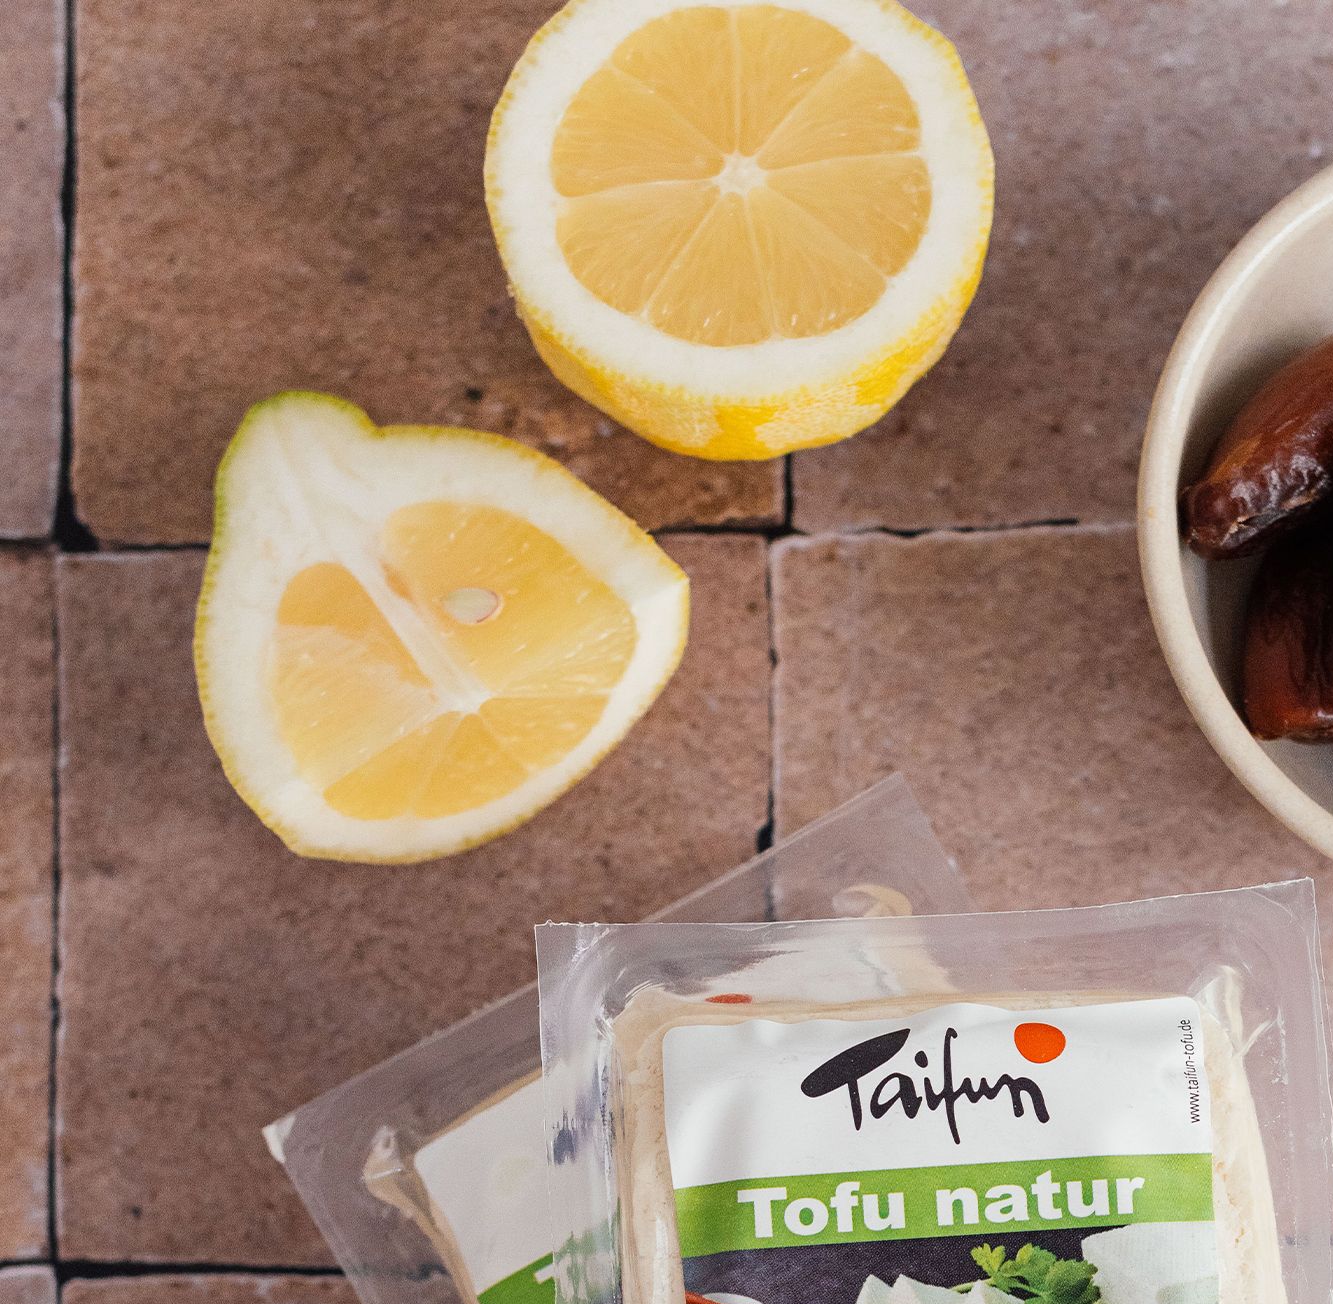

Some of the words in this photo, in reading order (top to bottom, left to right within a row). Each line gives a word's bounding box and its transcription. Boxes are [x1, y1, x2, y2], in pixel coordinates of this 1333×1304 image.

[800, 1027, 1050, 1145] Taifun
[1178, 1019, 1200, 1123] www.taifun-tofu.de
[737, 1181, 906, 1239] Tofu
[936, 1170, 1145, 1226] natur
